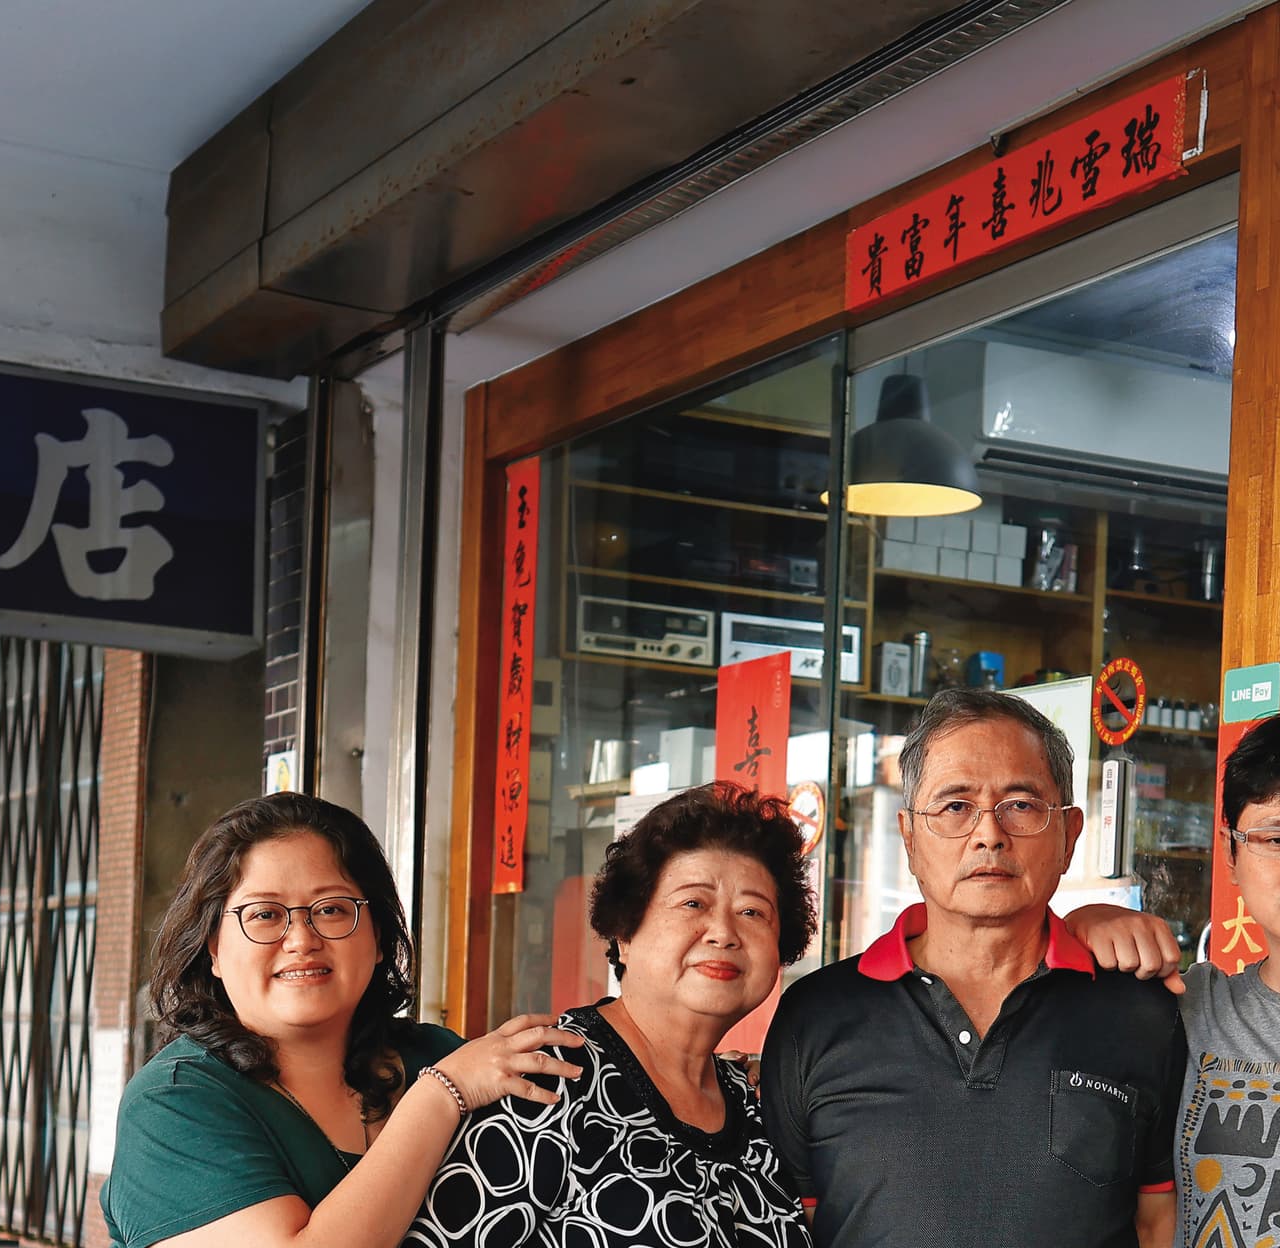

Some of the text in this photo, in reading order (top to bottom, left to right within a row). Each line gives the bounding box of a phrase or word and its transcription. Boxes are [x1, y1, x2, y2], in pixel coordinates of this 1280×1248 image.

[1231, 683, 1271, 702] LINE Pay
[1086, 1079, 1129, 1104] NOVARTIS
